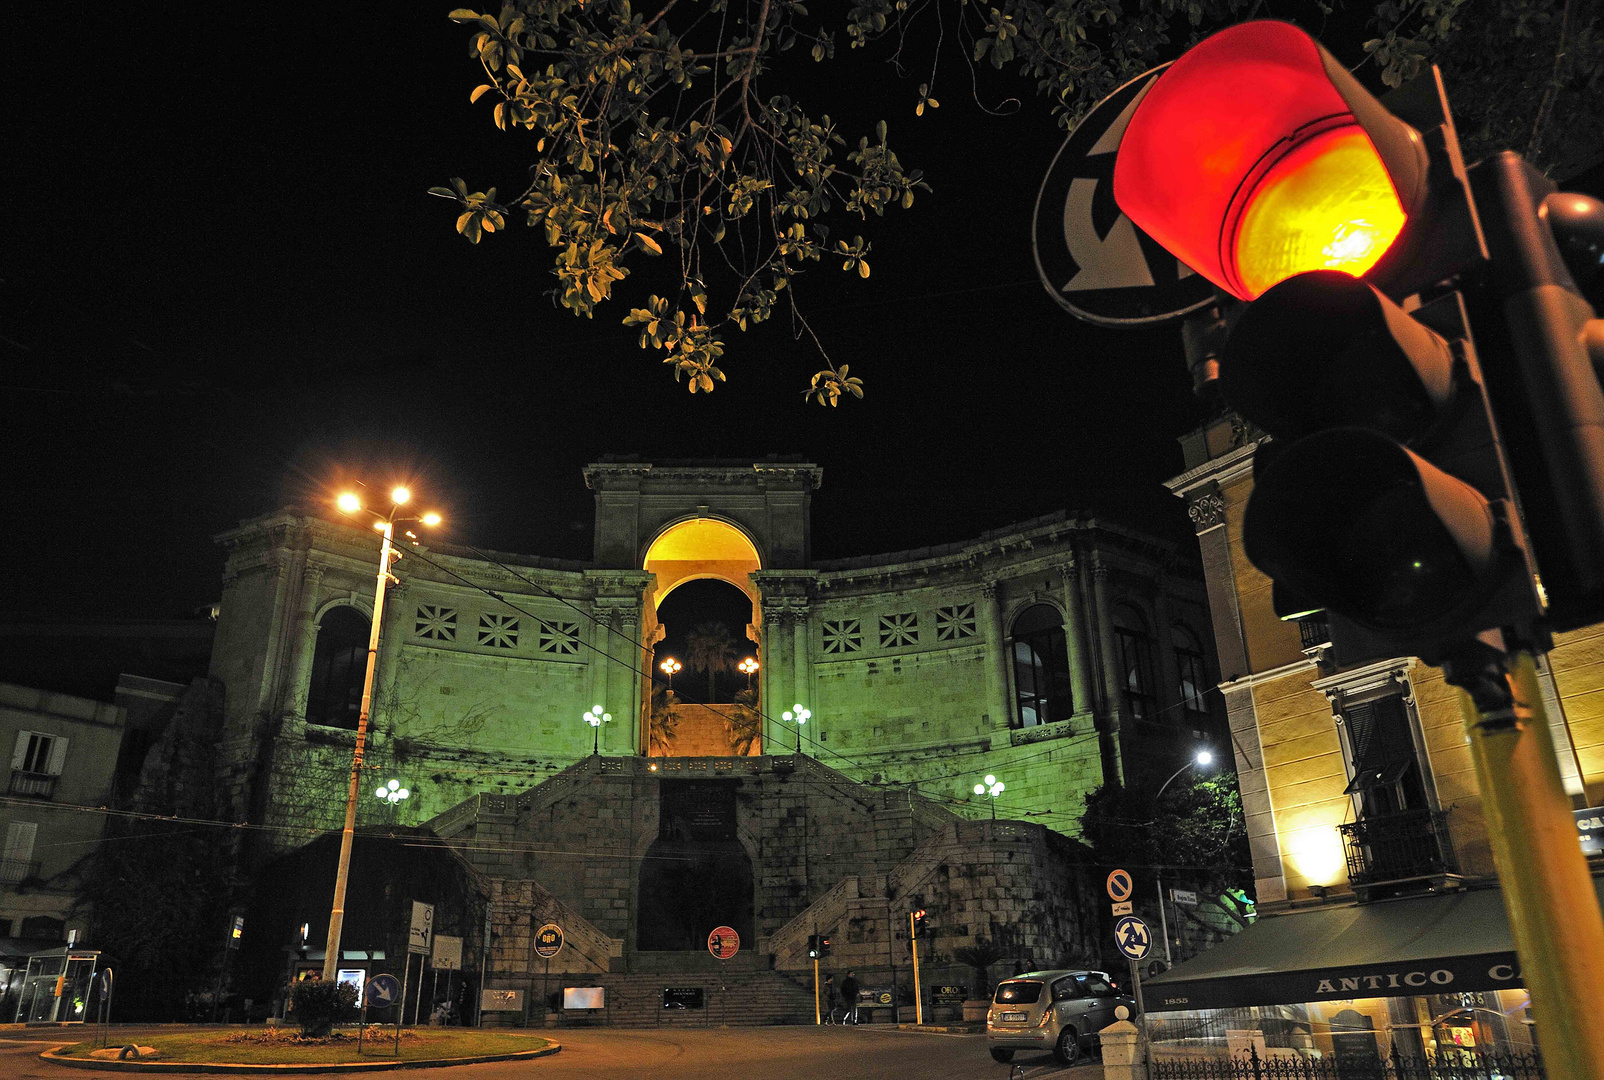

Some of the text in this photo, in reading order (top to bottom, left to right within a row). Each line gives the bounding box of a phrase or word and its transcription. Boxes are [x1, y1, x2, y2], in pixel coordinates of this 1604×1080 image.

[1315, 964, 1522, 994] ANTICO C
[941, 986, 958, 994] ORO
[1164, 997, 1189, 1005] 1855
